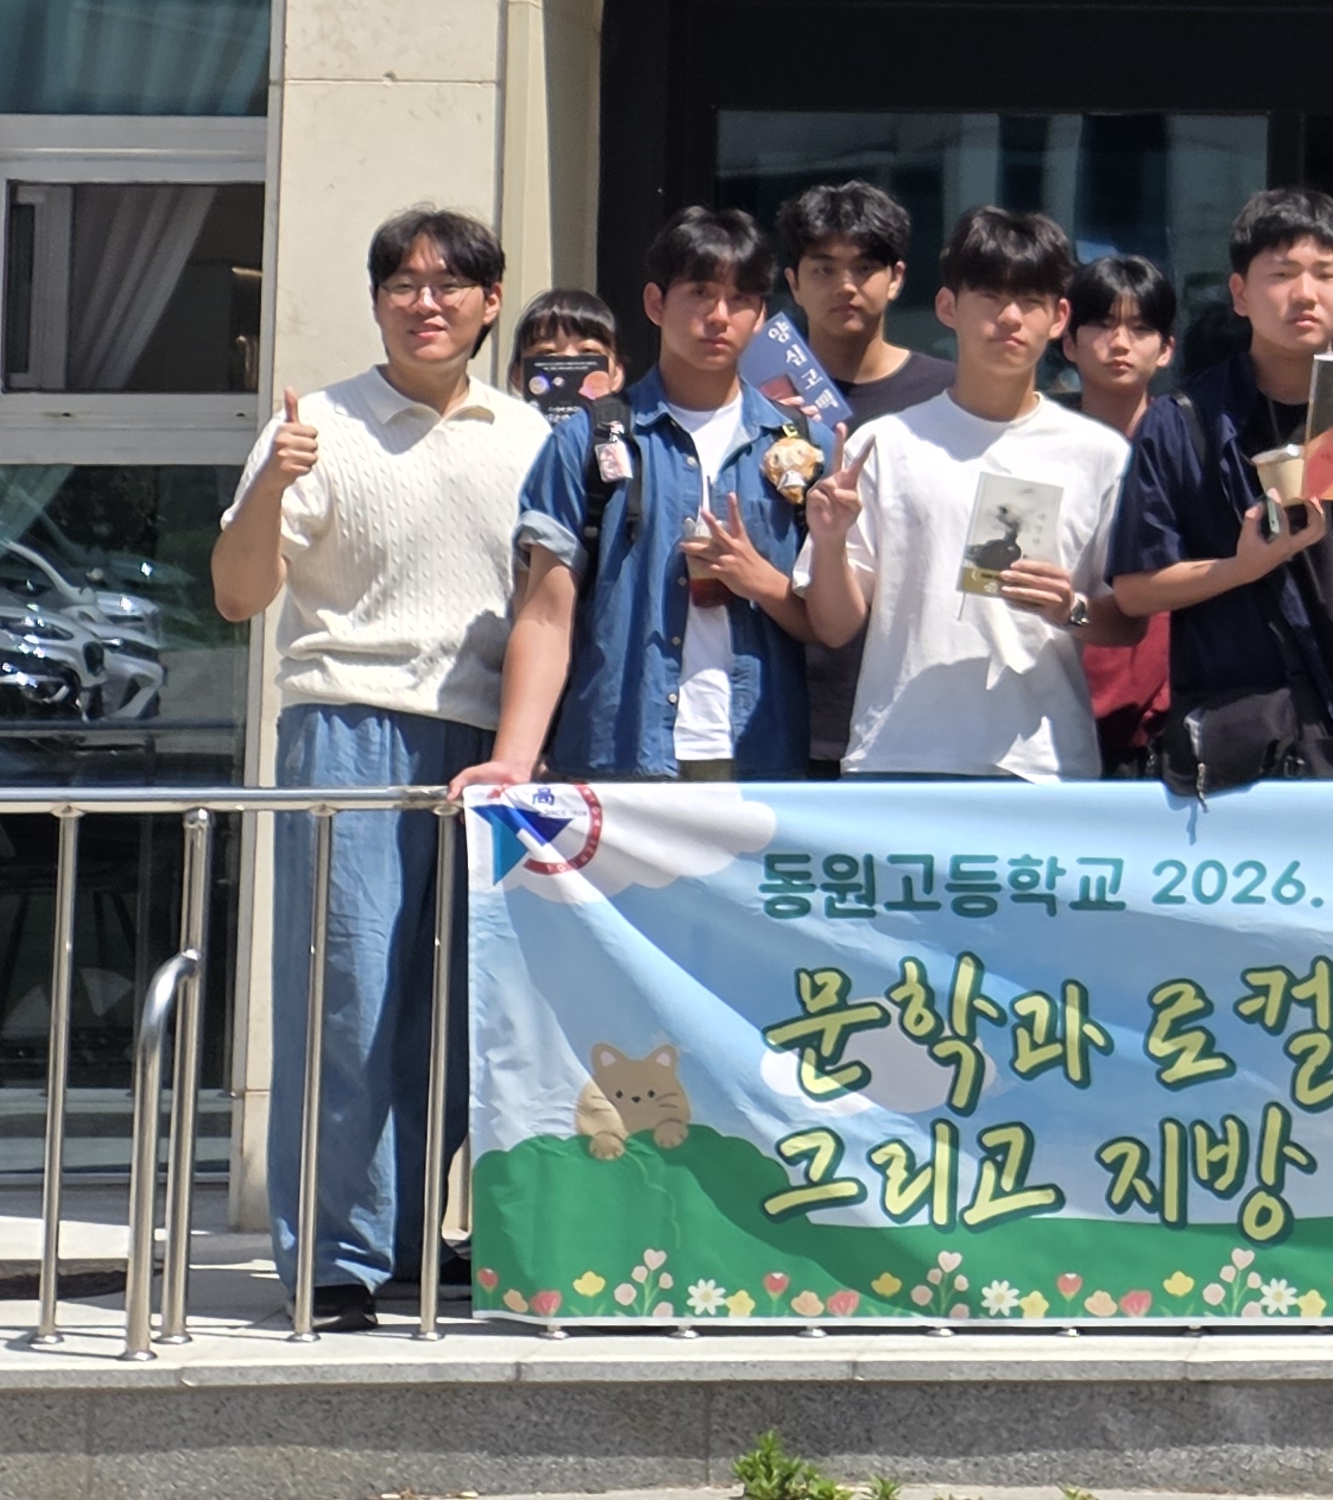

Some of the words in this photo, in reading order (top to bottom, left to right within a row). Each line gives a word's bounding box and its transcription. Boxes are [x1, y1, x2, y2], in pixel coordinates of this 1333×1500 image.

[768, 321, 839, 409] 양심고백
[758, 851, 1129, 919] 동원고등학교
[1152, 858, 1325, 909] 2026.
[762, 950, 1114, 1116] 문학과
[762, 1117, 1066, 1234] 그리고
[1096, 1100, 1317, 1247] 지방
